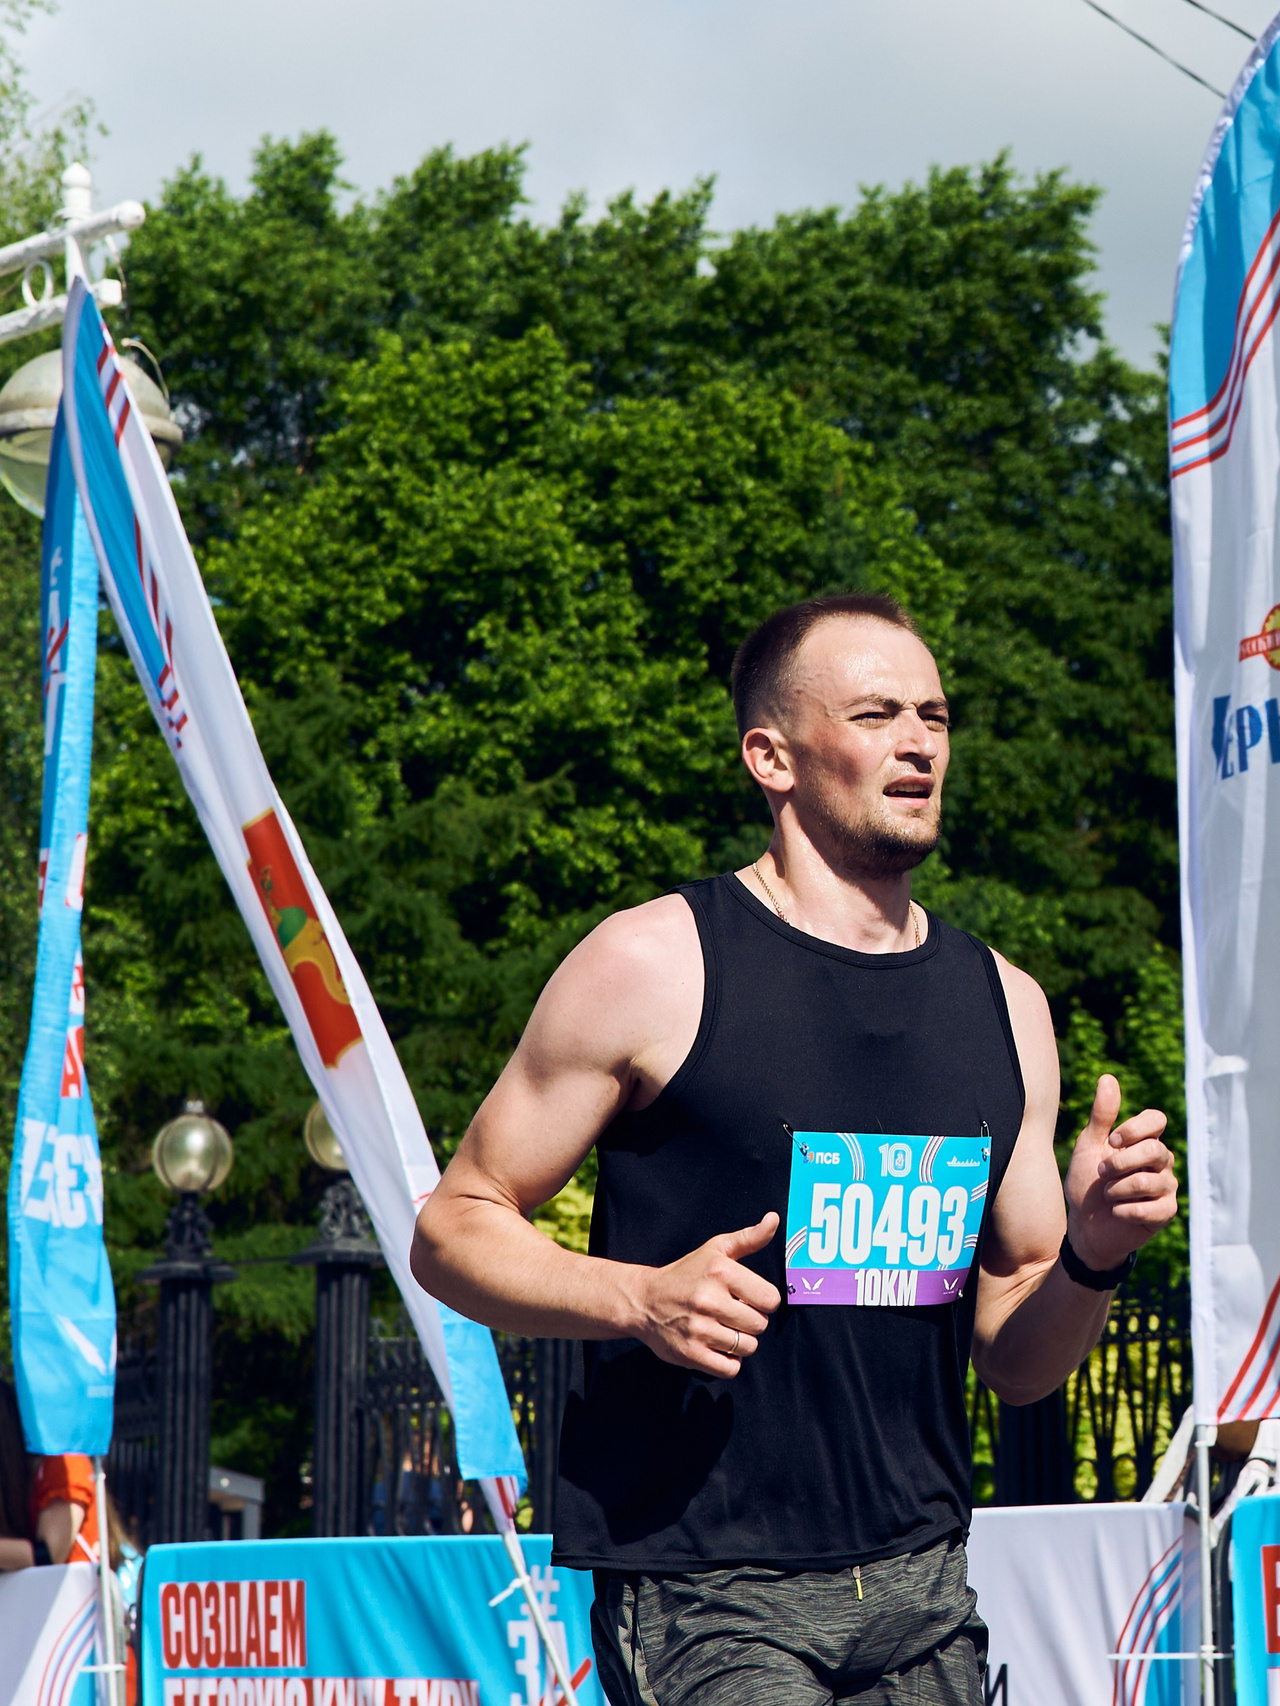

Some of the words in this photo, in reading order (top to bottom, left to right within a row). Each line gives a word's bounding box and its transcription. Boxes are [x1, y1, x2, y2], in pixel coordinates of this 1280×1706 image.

[815, 1151, 841, 1165] ПСБ
[878, 1143, 912, 1178] 10
[808, 1182, 969, 1267] 50493
[160, 1580, 307, 1669] СОЗДАЕМ
